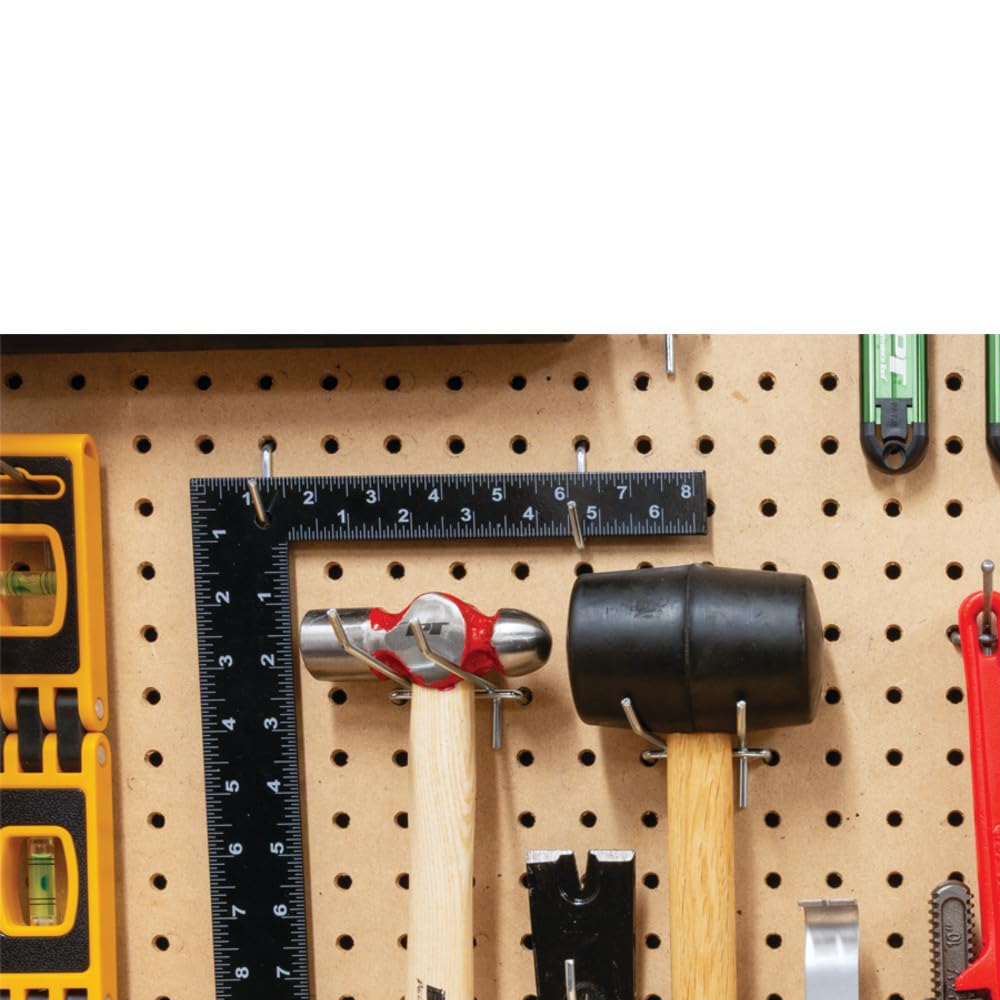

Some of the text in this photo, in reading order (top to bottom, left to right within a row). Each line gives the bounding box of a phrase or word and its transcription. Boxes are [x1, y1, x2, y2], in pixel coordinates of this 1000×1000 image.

[242, 484, 692, 506] 1 2 3 4 5 6 7 8
[337, 504, 660, 524] 1 2 3 4 5 6
[212, 529, 226, 539] 1
[215, 591, 230, 604] 2
[257, 593, 272, 602] 1
[218, 655, 233, 667] 3
[260, 654, 275, 666] 2
[221, 717, 236, 731] 4
[263, 717, 278, 729] 3
[225, 780, 240, 793] 5
[266, 779, 281, 793] 4
[228, 842, 243, 855] 6
[270, 842, 284, 854] 5
[231, 905, 246, 917] 7
[273, 904, 288, 917] 6
[235, 966, 249, 979] 8
[276, 966, 290, 978] 7
